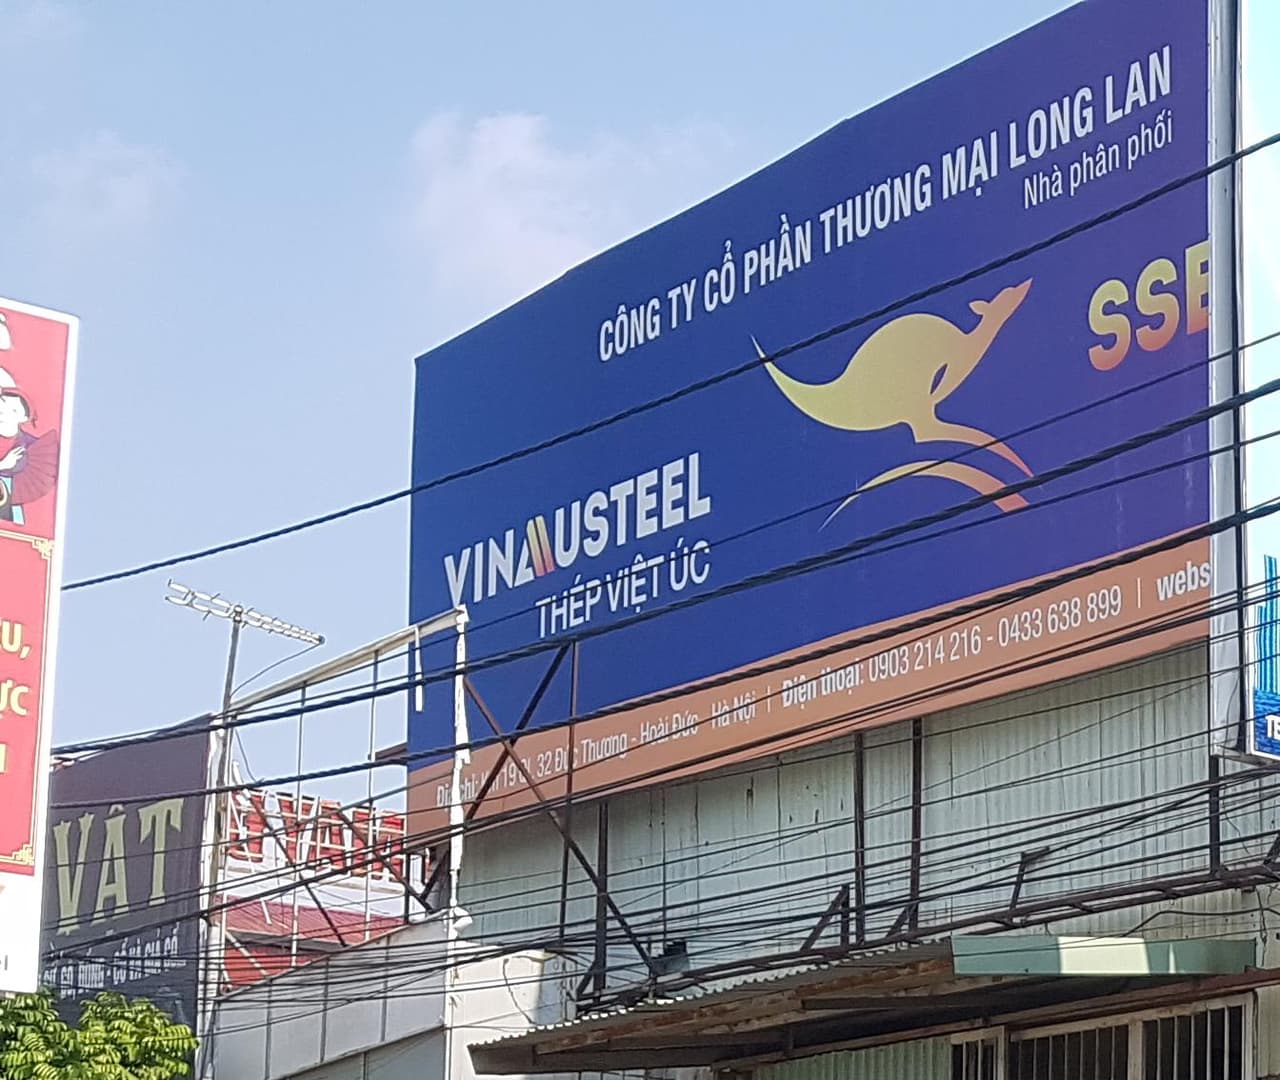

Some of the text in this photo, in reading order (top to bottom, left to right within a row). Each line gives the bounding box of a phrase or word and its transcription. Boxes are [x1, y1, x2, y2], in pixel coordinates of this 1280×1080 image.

[599, 44, 1172, 362] CÔNG TY CỔ PHẦN THƯƠNG MẠI LONG LAN
[1023, 108, 1174, 210] Nhà phân phối
[443, 451, 712, 610] VINAUSTEEL
[535, 537, 711, 639] THÉP VIỆT ÚC
[503, 761, 518, 788] 19
[537, 751, 552, 778] 32
[640, 715, 669, 745] Hoài
[671, 710, 699, 740] Đức
[711, 699, 731, 729] Hà
[733, 690, 757, 725] Nội
[781, 673, 817, 710] Điện
[821, 660, 864, 696] thoại:
[868, 644, 909, 683] 0903
[913, 639, 945, 672] 214
[949, 624, 982, 663] 216
[998, 608, 1042, 647] 0433
[1047, 596, 1081, 634] 638
[1086, 584, 1122, 624] 899
